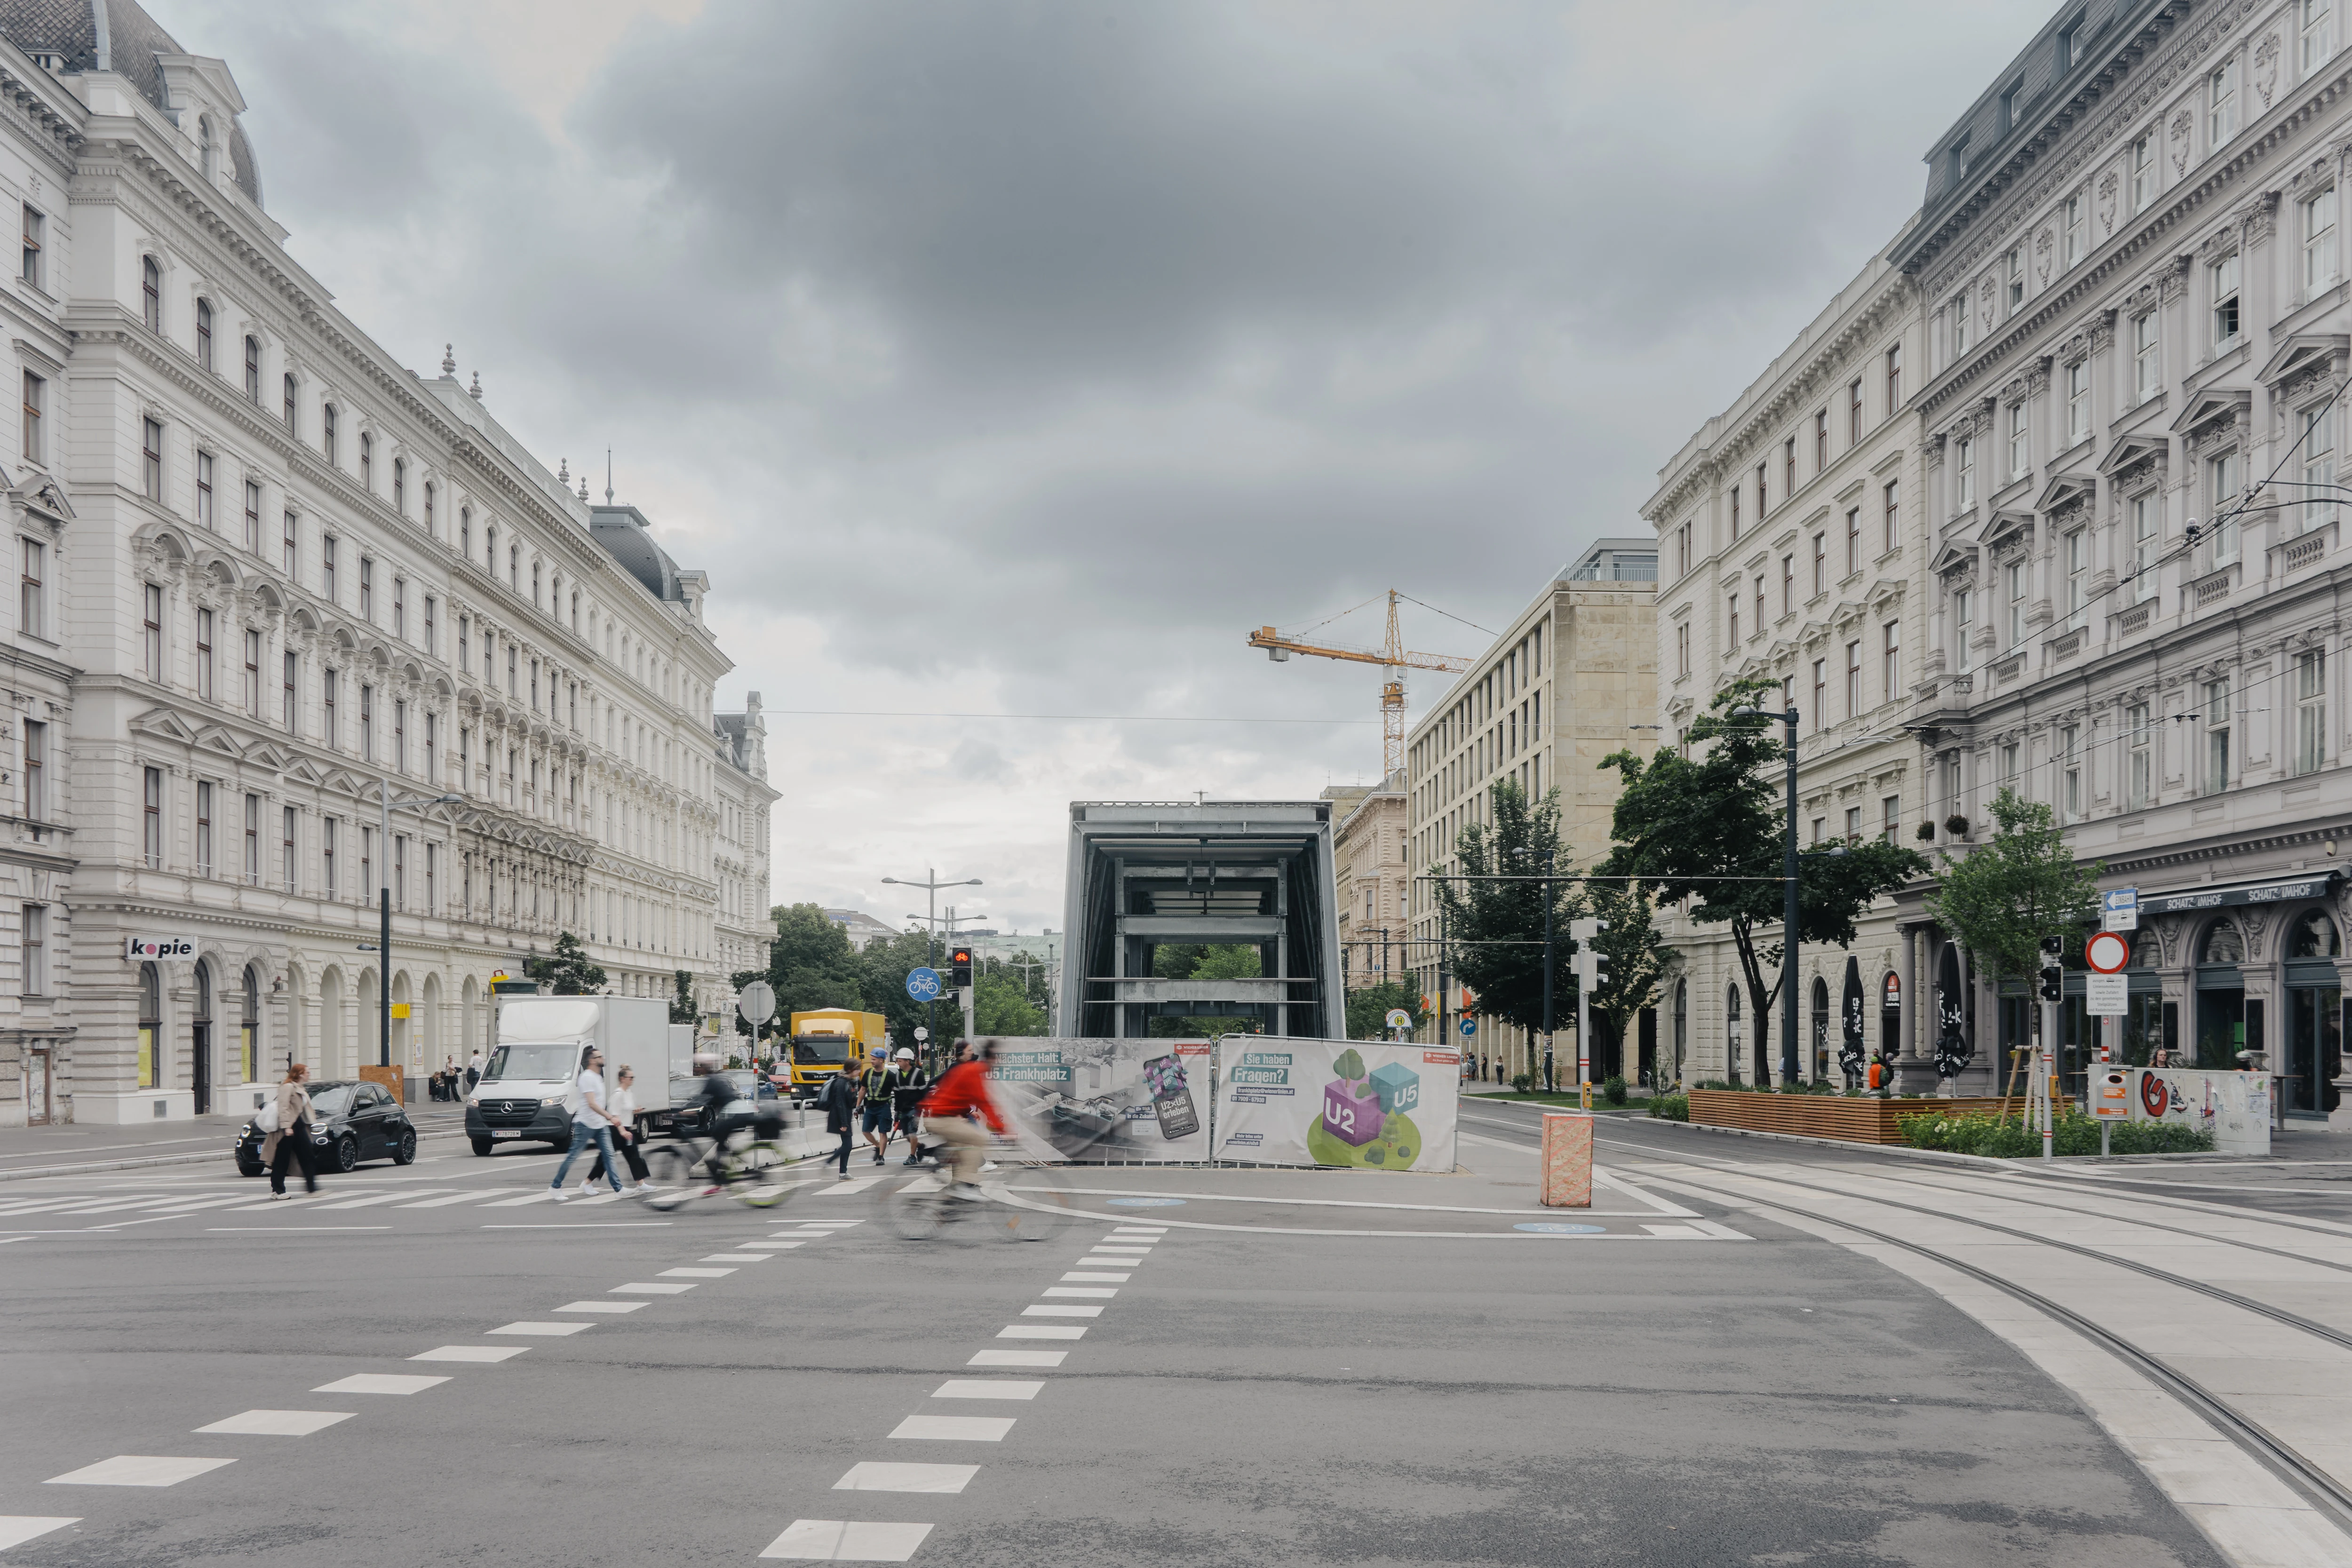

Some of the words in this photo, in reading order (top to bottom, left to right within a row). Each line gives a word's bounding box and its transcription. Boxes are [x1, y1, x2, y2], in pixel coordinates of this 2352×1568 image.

[2115, 895, 2132, 904] EINBAHN
[995, 1053, 1035, 1064] Nächster
[1038, 1052, 1059, 1063] Halt:
[1247, 1054, 1260, 1064] Sie
[1263, 1054, 1289, 1065] haben
[985, 1067, 1000, 1079] U5
[1002, 1067, 1067, 1083] Frankhplatz
[1234, 1067, 1284, 1085] Fragen?
[1394, 1083, 1417, 1107] U5
[1163, 1106, 1190, 1119] erleben
[1325, 1097, 1355, 1135] U2
